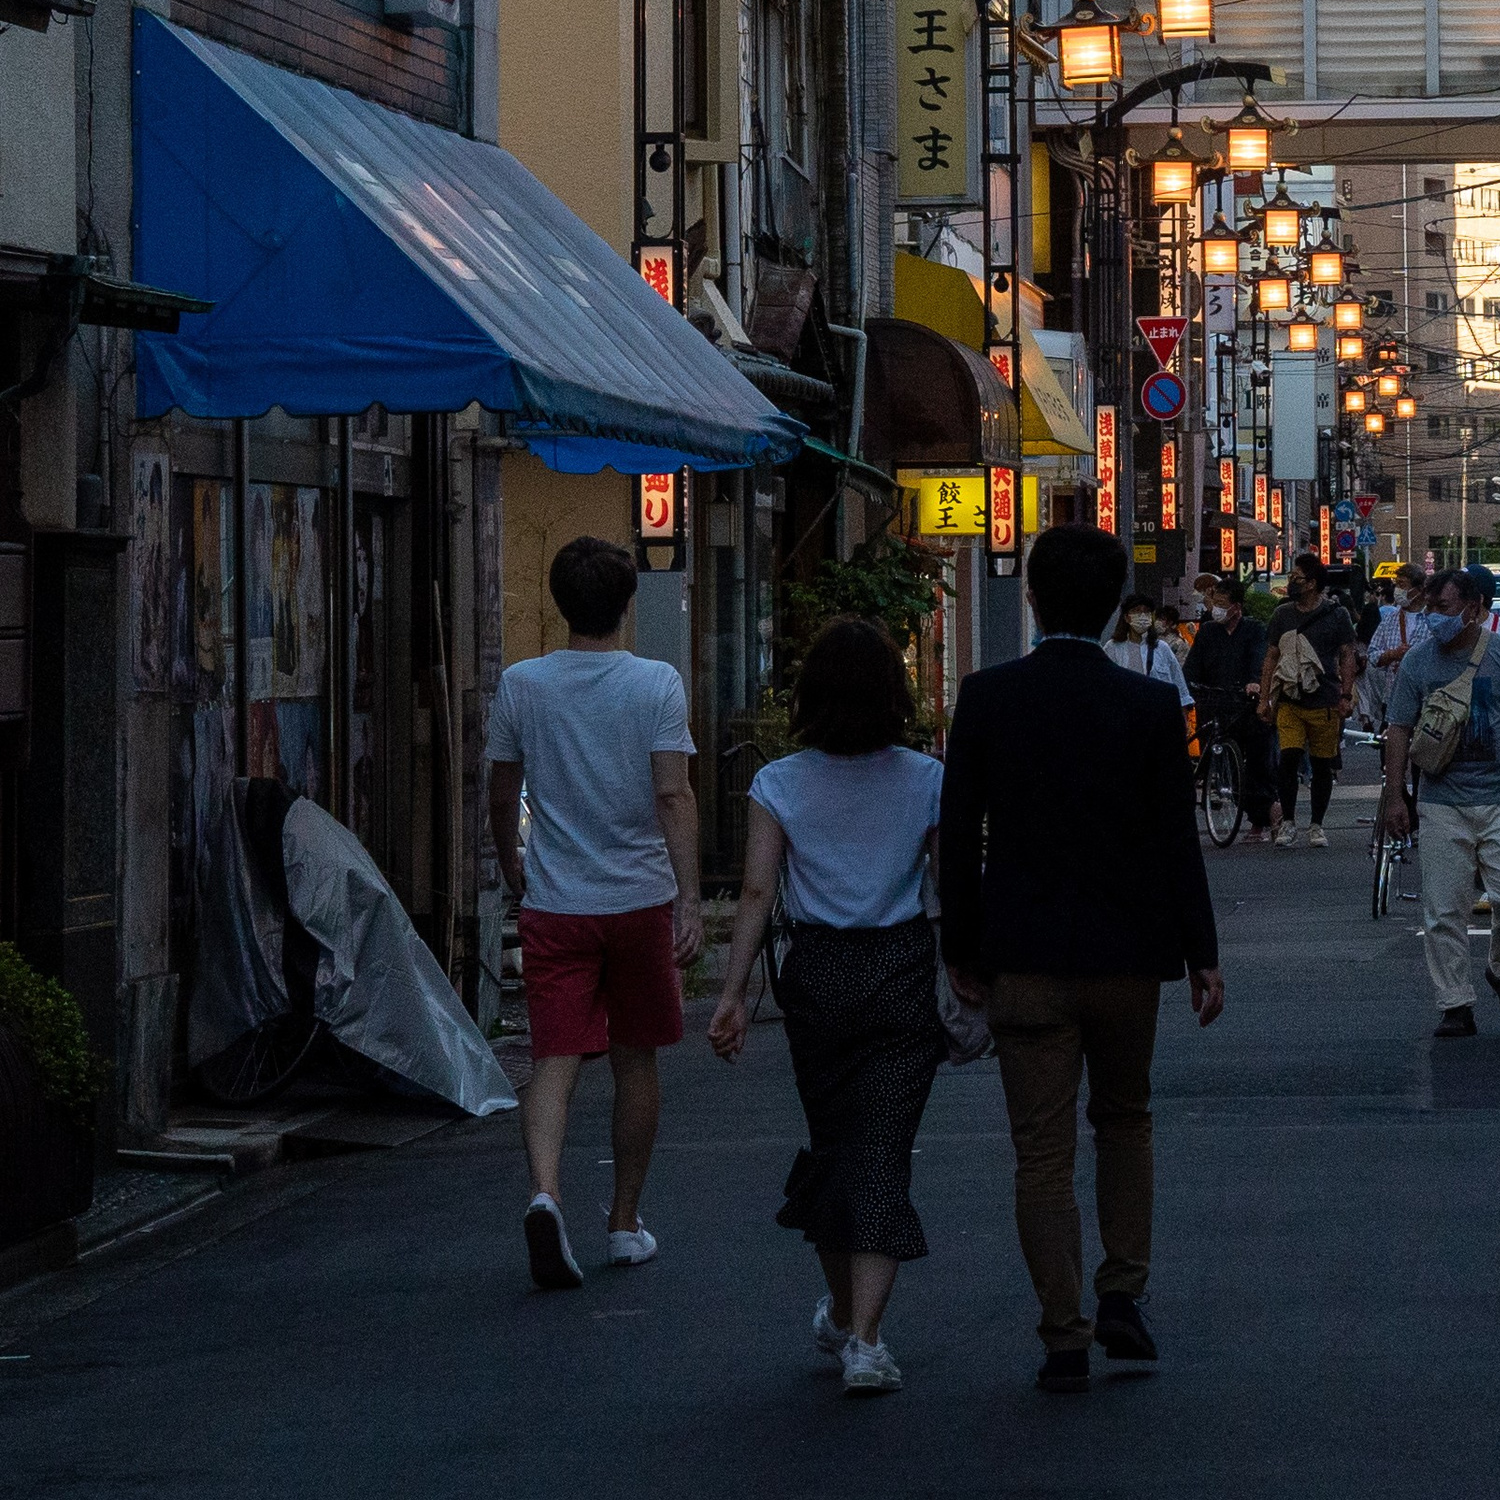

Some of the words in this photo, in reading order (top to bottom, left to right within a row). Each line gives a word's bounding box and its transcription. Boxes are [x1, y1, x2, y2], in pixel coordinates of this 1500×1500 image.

[1148, 326, 1180, 339] 止まれ
[1098, 412, 1113, 536] 浅草中央通
